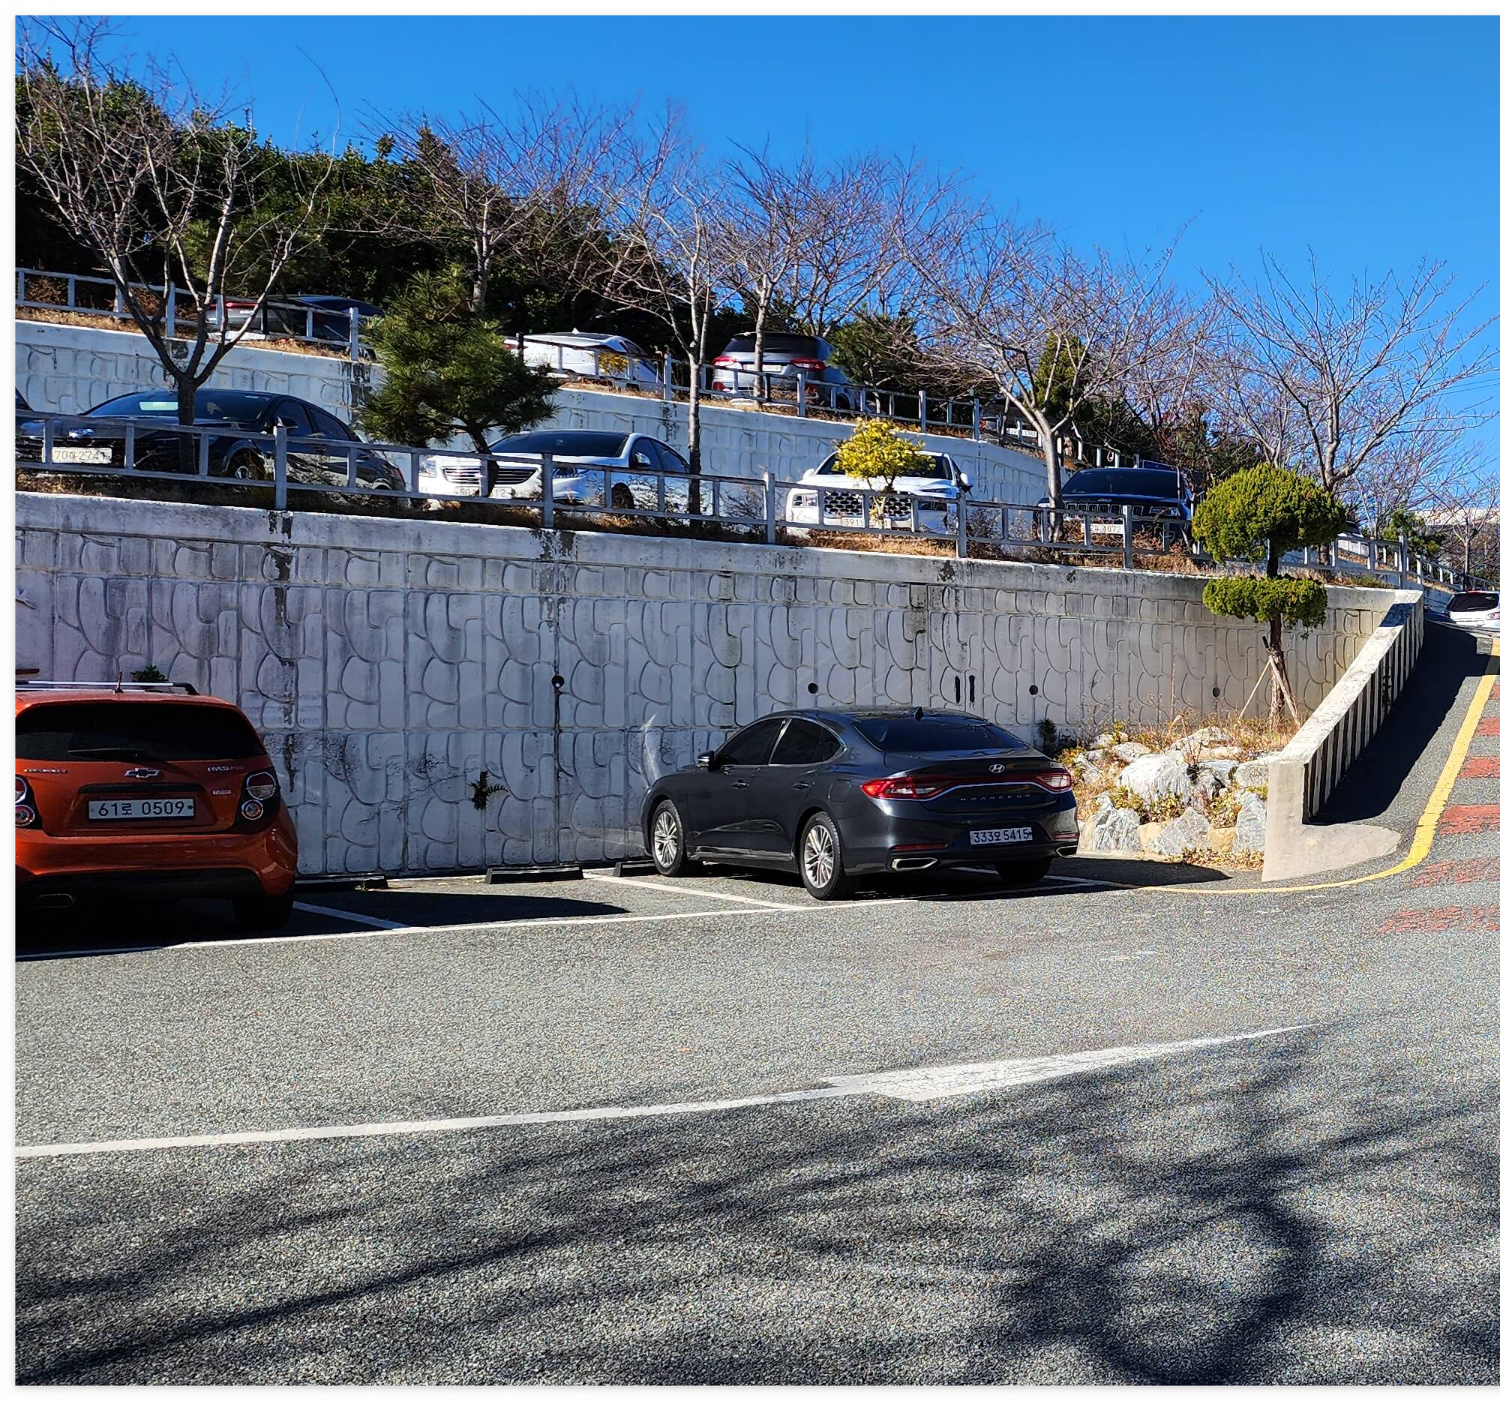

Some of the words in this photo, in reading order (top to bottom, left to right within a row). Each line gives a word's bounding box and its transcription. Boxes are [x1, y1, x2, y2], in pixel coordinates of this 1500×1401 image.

[98, 802, 133, 817] 61로
[141, 801, 185, 816] 0509
[1003, 829, 1030, 841] 5415
